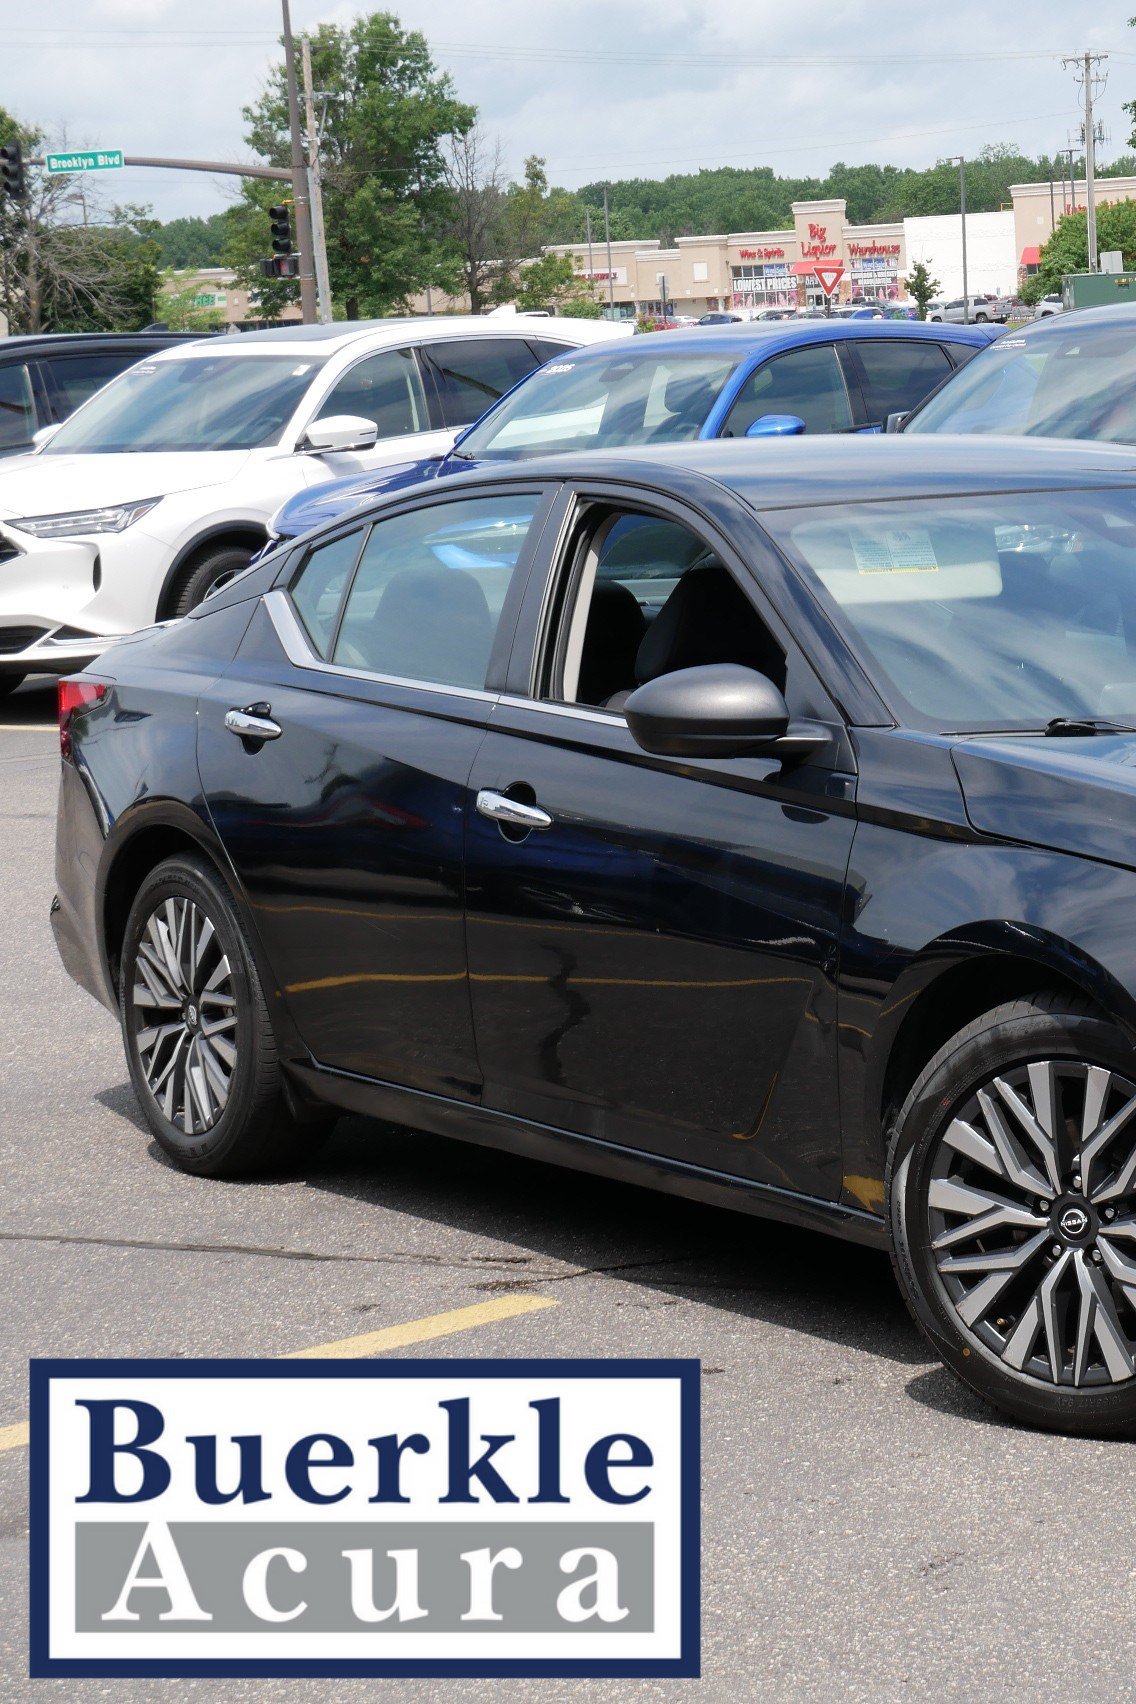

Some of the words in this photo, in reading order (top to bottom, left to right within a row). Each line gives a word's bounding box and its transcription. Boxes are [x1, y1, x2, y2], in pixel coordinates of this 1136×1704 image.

[50, 157, 95, 169] Brooklyn
[97, 154, 120, 165] Blvd
[808, 223, 826, 242] Big
[764, 247, 784, 259] Spirits
[801, 241, 836, 260] Liquor
[847, 240, 900, 256] Warehouse
[733, 279, 766, 292] LOWEST
[766, 276, 798, 290] PRICES
[1060, 1217, 1088, 1227] NISSAN
